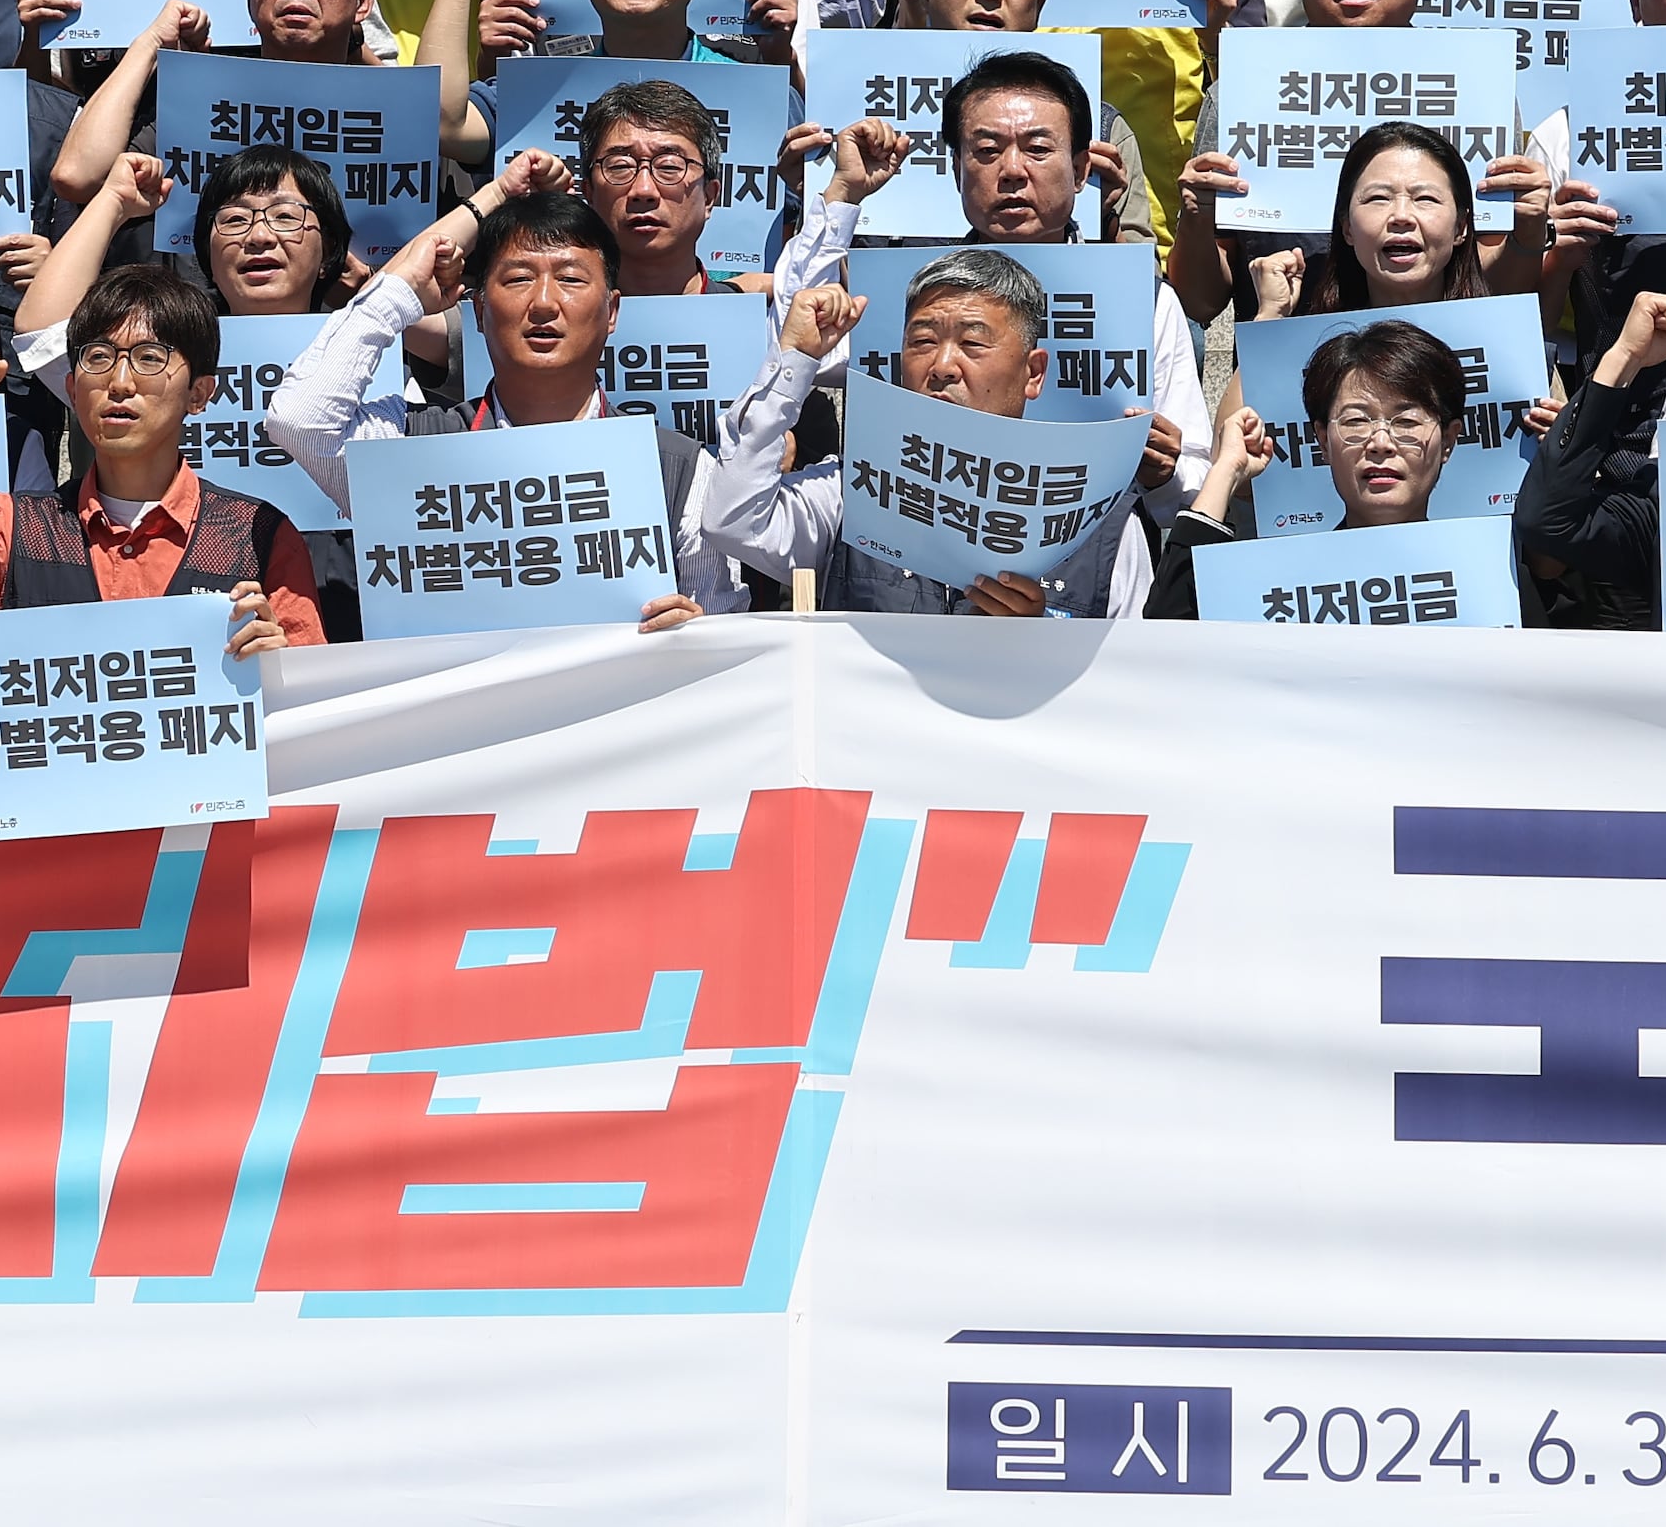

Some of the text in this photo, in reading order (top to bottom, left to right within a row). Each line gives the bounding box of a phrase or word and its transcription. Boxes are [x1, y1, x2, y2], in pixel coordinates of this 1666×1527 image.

[415, 471, 610, 533] 최저임금
[365, 525, 668, 593] 차별적용 폐지
[0, 647, 196, 707] 최저임금
[158, 701, 256, 755] 폐지
[988, 1397, 1068, 1482] 일
[1110, 1400, 1188, 1485] 시
[1260, 1405, 1502, 1485] 2024.
[1529, 1408, 1596, 1487] 6.
